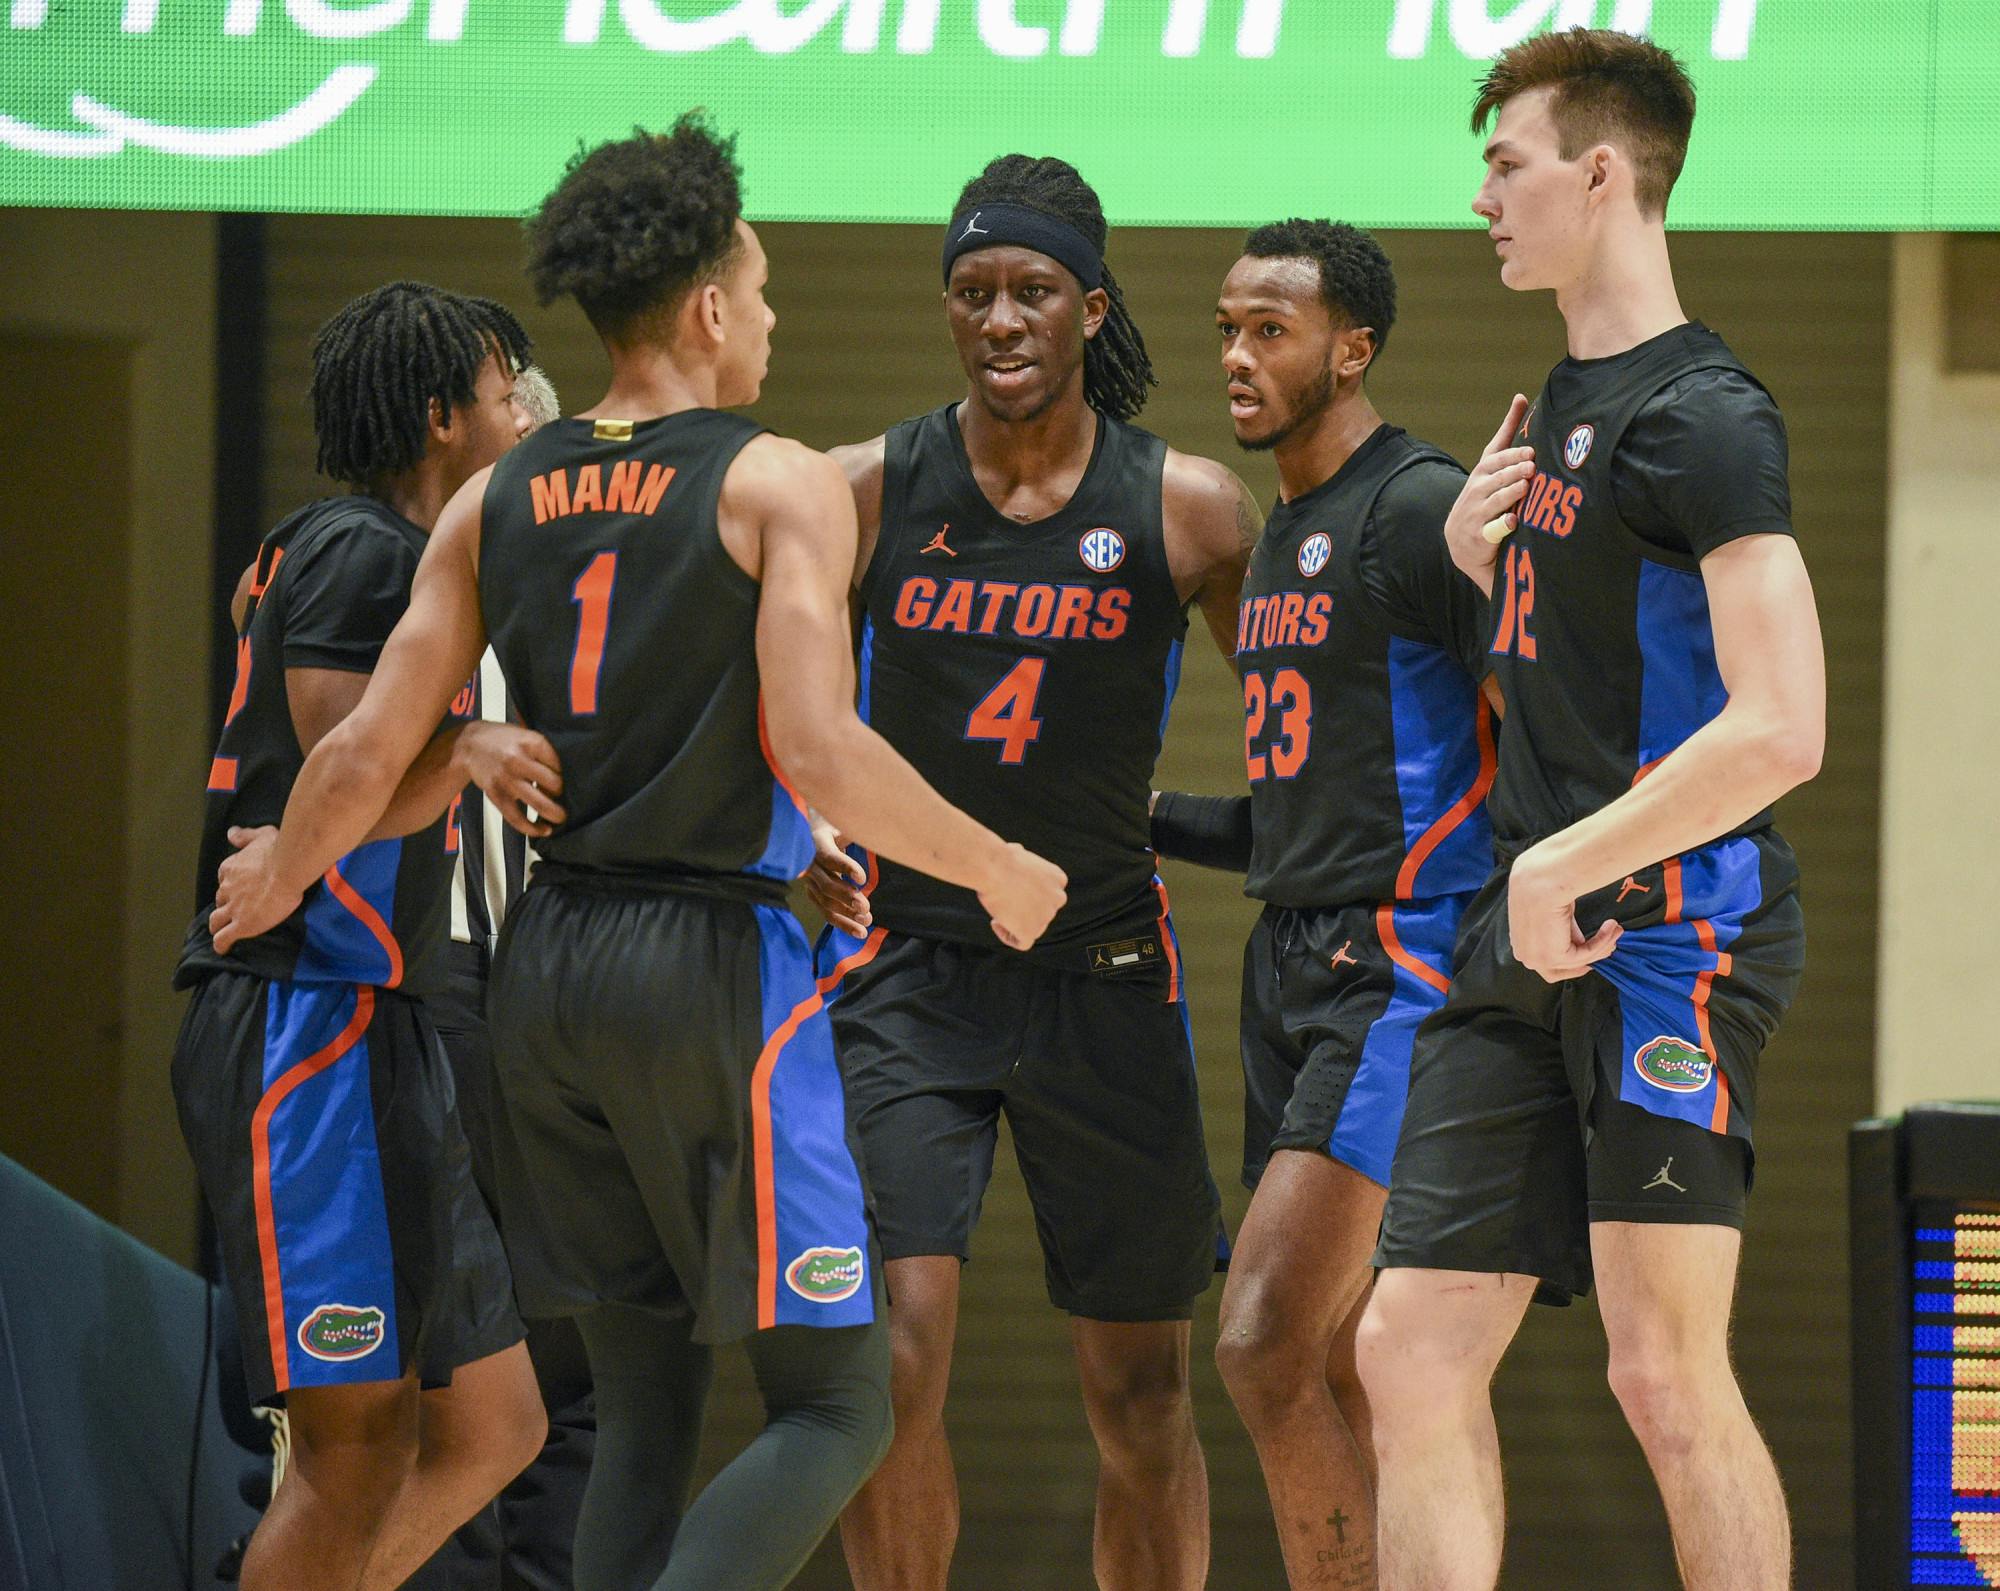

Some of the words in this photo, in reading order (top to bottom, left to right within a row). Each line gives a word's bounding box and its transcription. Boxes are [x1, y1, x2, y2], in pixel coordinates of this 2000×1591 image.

[529, 460, 677, 525] MANN
[1081, 530, 1122, 570] SEC
[1301, 534, 1331, 575] SEC
[571, 550, 618, 717] 1
[893, 575, 1132, 641] GATORS
[1489, 541, 1538, 663] 12
[964, 654, 1048, 766] 4
[1244, 666, 1313, 785] 23
